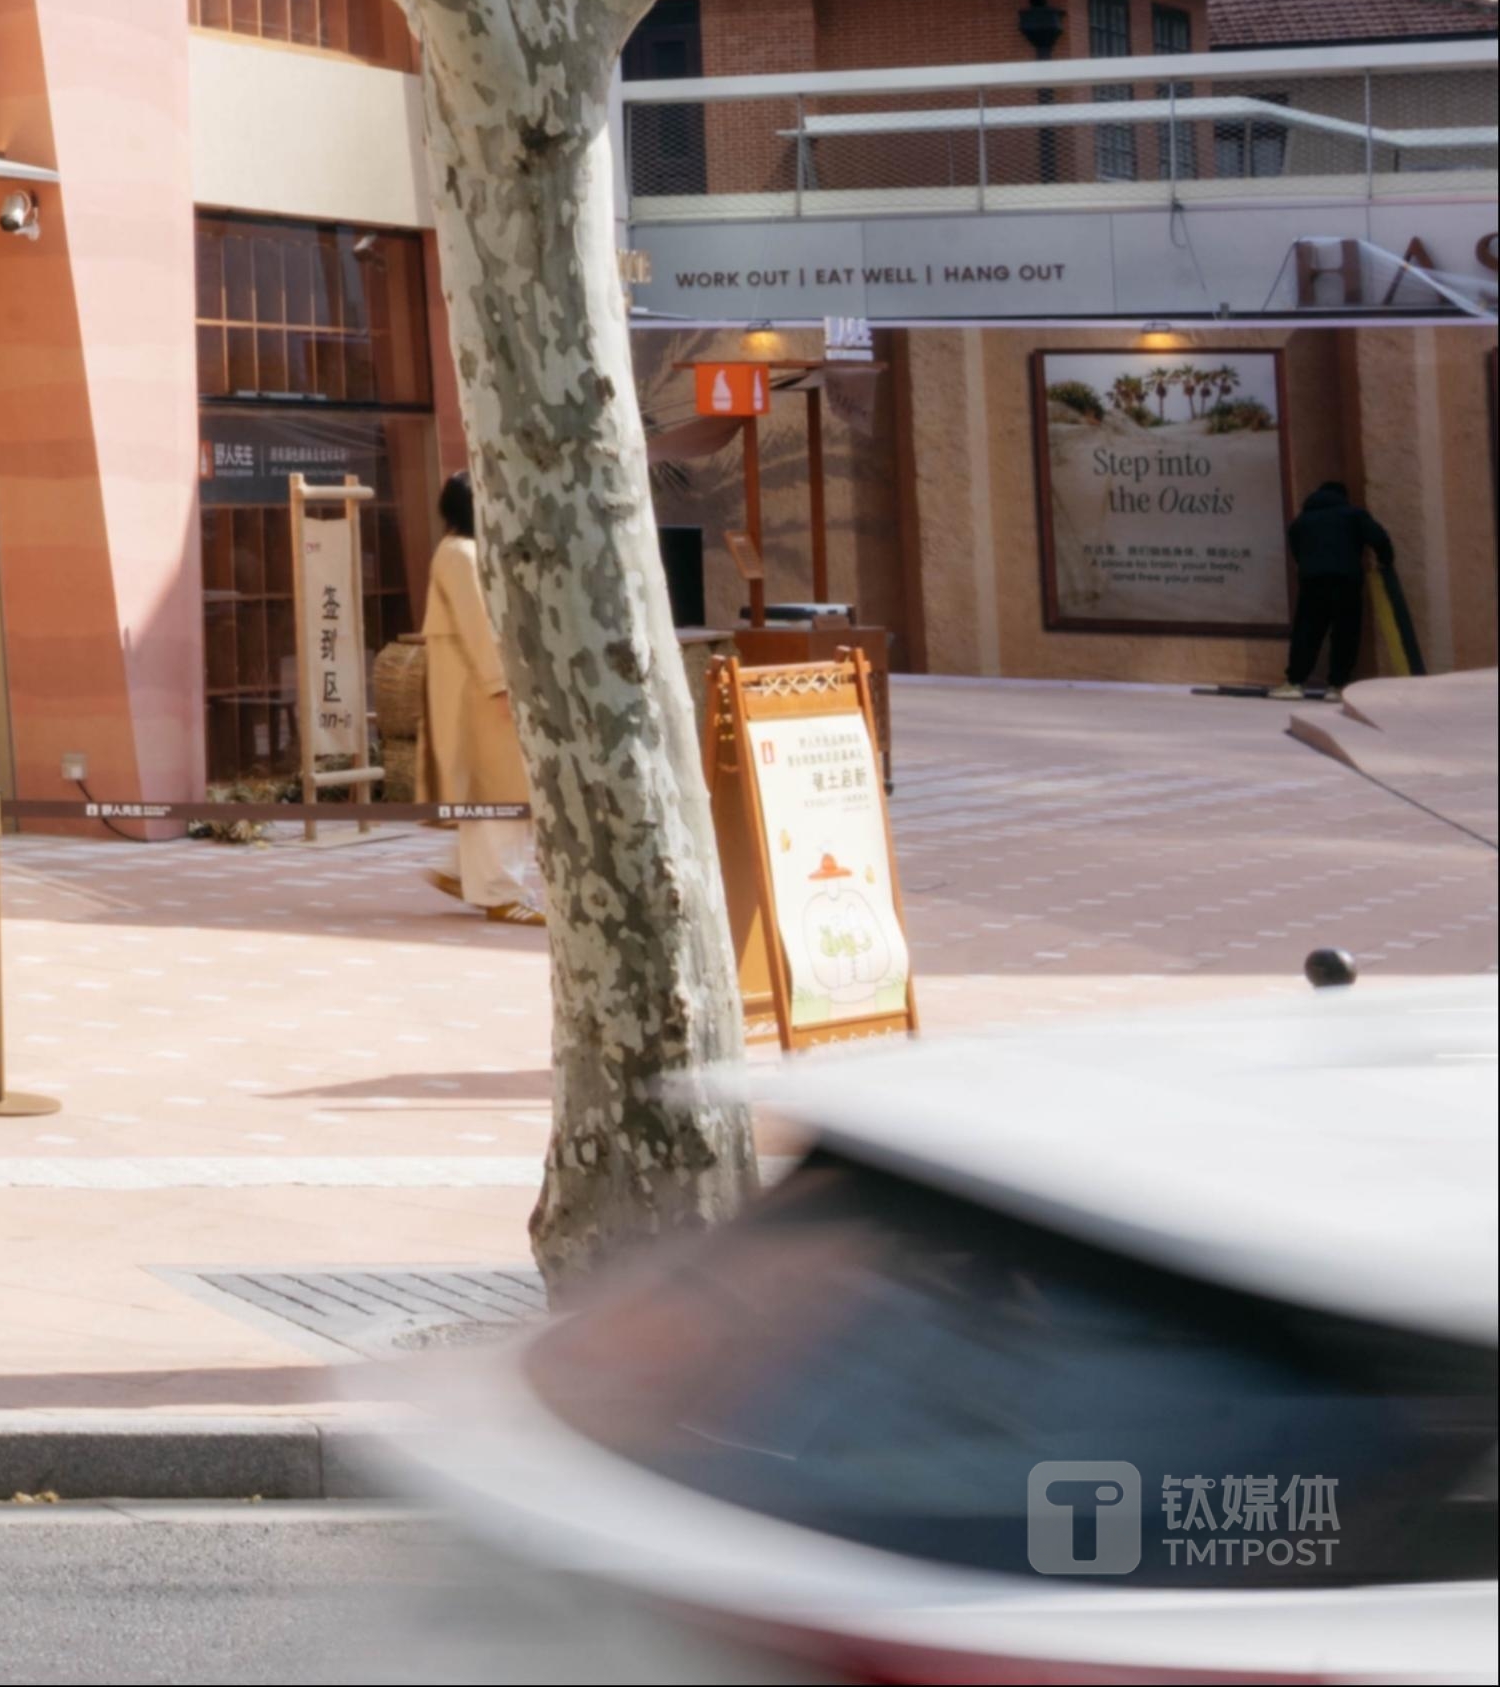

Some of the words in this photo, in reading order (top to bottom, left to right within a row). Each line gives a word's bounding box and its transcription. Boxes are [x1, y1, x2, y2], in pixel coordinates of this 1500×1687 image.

[675, 271, 740, 289] WORK
[747, 269, 791, 287] OUT
[815, 267, 855, 285] EAT
[862, 267, 917, 285] WELL
[944, 264, 1010, 283] HANG
[1019, 263, 1066, 282] OUT
[1093, 448, 1149, 483] Step
[1157, 449, 1212, 477] into
[1107, 485, 1150, 513] the
[1158, 485, 1235, 514] Oasis
